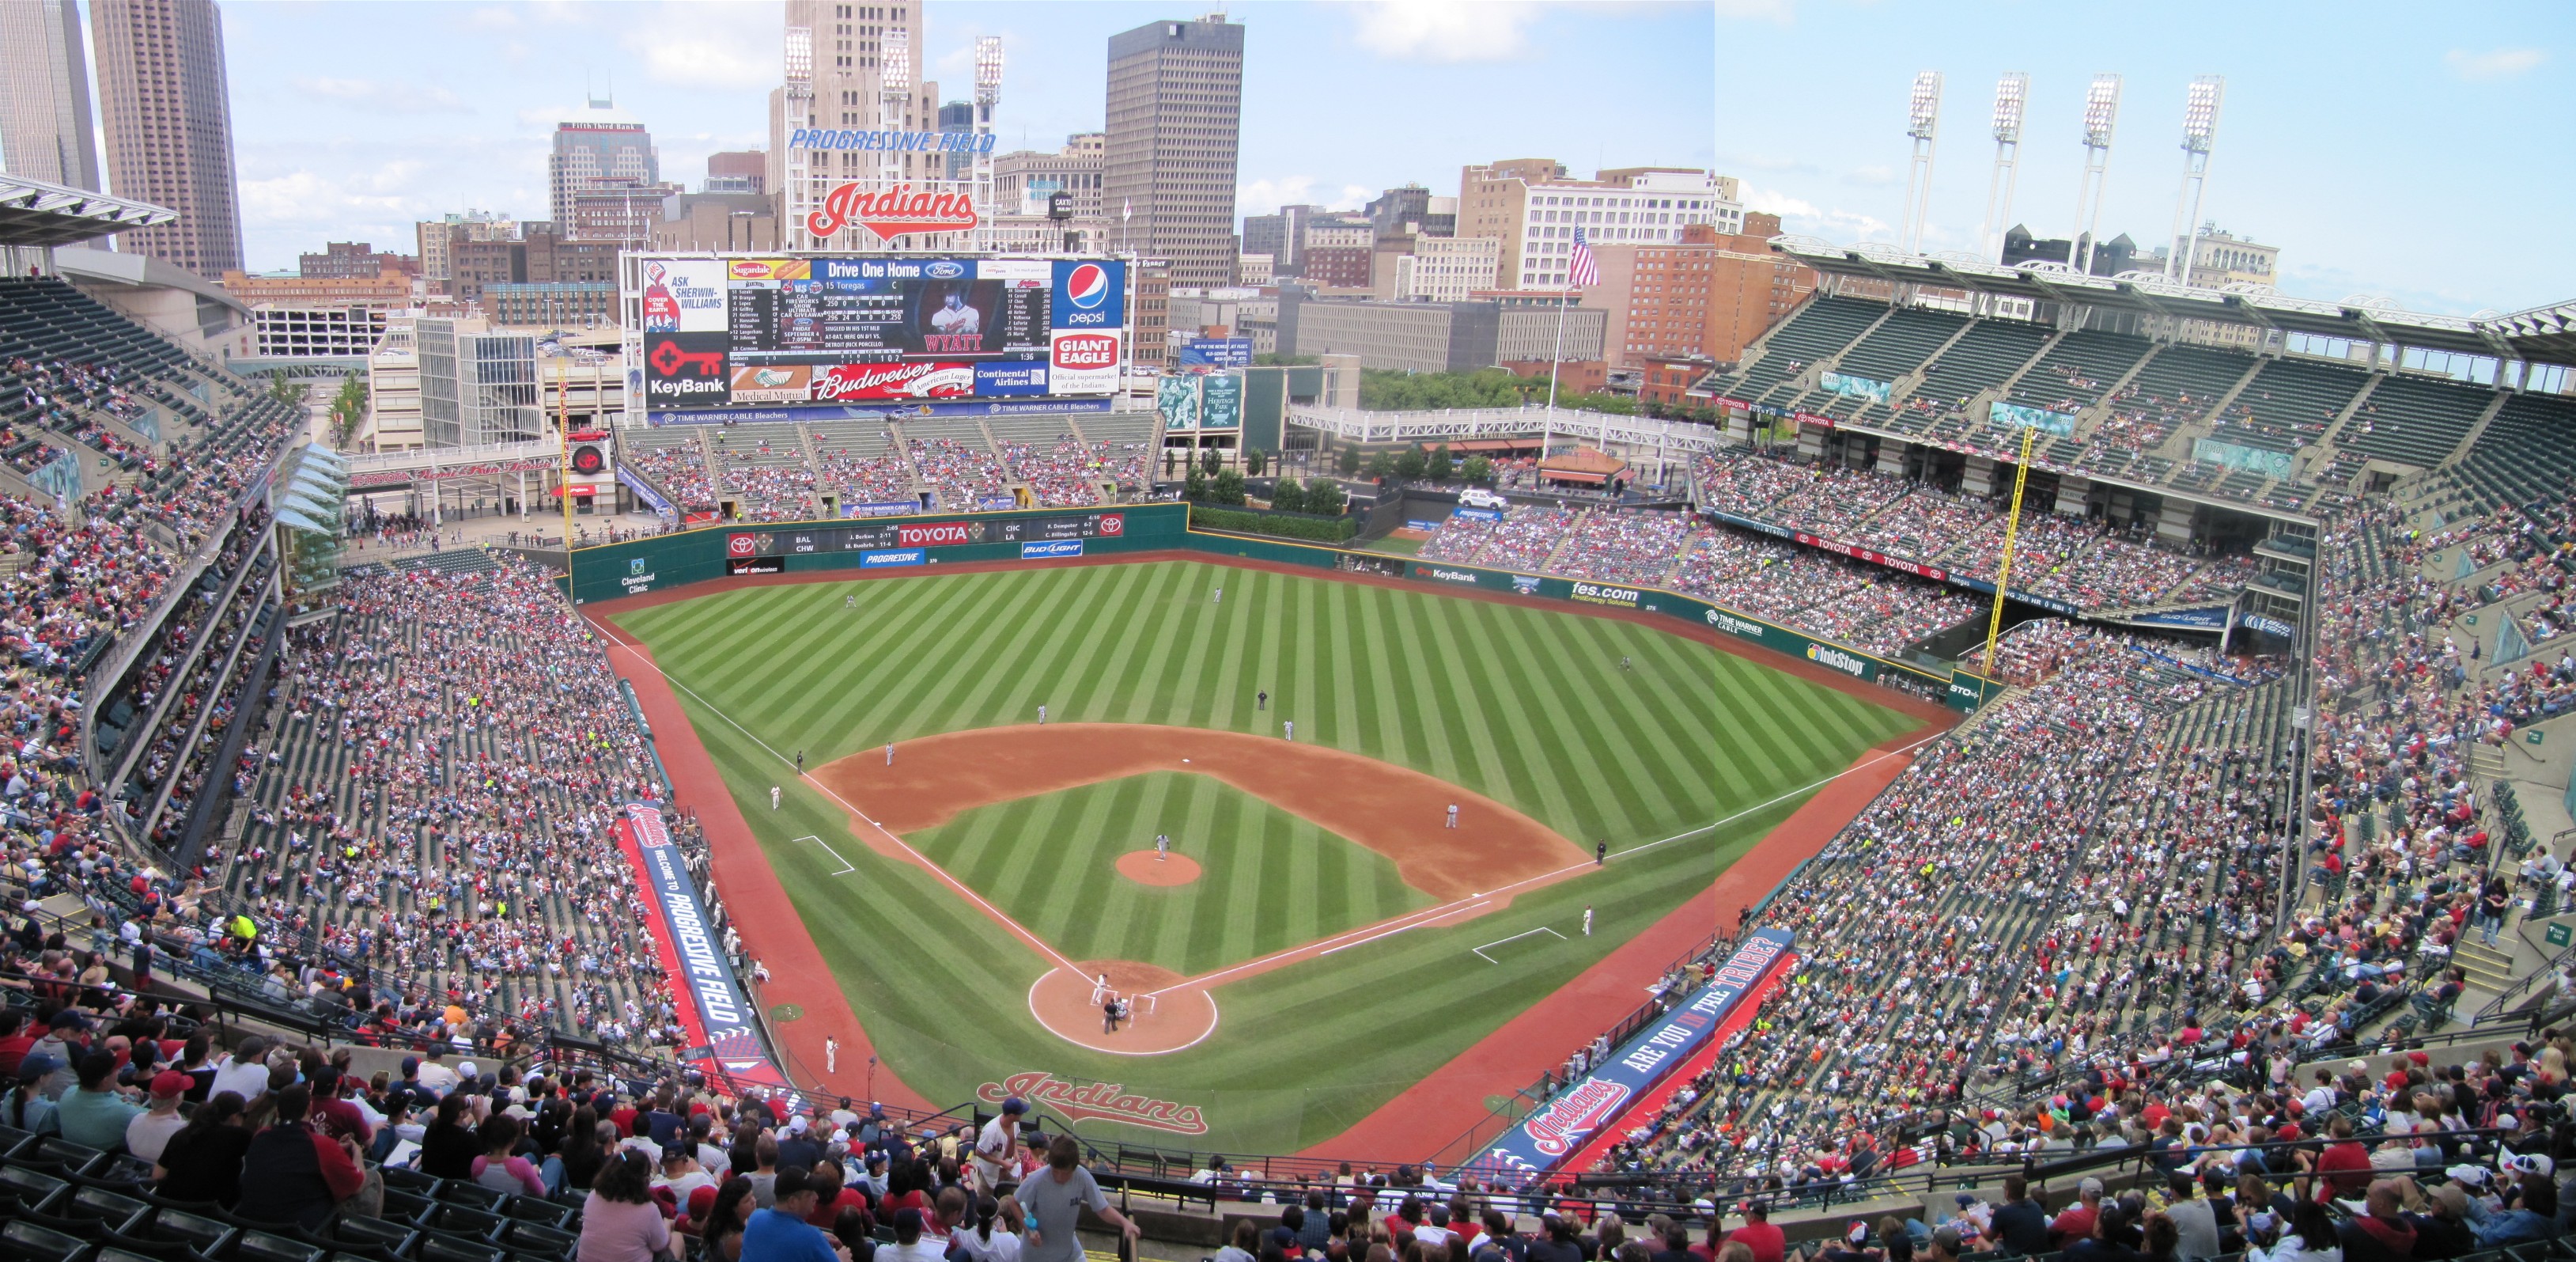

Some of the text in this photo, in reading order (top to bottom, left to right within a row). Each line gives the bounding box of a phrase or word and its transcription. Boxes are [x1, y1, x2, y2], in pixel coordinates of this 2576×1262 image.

[789, 129, 997, 153] PROGRESSIVE FIELD
[807, 180, 979, 243] Indians
[733, 263, 770, 276] Sugardale
[829, 263, 920, 278] Drive One Home
[933, 264, 955, 275] Ford
[671, 277, 689, 286] ASK
[675, 288, 717, 298] SHERWIN-
[681, 298, 722, 309] WILLIAMS
[1069, 311, 1105, 325] pepsi
[925, 334, 983, 351] WYATT
[1059, 340, 1112, 351] GIANT
[1061, 352, 1110, 364] EAGLE
[977, 369, 1029, 378] Continental
[651, 378, 724, 396] KeyBank
[813, 362, 934, 400] Budweiser
[916, 373, 971, 392] American Lager
[994, 377, 1029, 386] Airlines
[736, 390, 806, 401] Medical Mutual
[1725, 400, 1745, 409] TOYOTA
[560, 381, 569, 460] WALGREENS
[1807, 416, 1829, 426] TOYOTA
[1449, 434, 1482, 442] MARKET
[2199, 442, 2226, 455] LEMON
[365, 472, 410, 484] TOYOTA
[623, 471, 659, 501] TIME WARNER CABLE
[640, 490, 656, 506] Bleachers
[1459, 510, 1495, 518] PROGRESSIVE
[900, 526, 966, 543] TOYOTA
[1818, 539, 1852, 555] TOYOTA
[866, 553, 919, 564] PROGRESSIVE
[1883, 556, 1919, 574] TOYOTA
[622, 573, 655, 586] Cleveland
[1432, 569, 1476, 582] KeyBank
[629, 584, 649, 594] Clinic
[1572, 582, 1639, 601] fes.com
[1949, 574, 1970, 586] Toregas
[2052, 603, 2064, 612] RBI
[1571, 594, 1636, 608] FirstEnergy Solutions
[1718, 623, 1738, 634] CABLE
[1719, 614, 1763, 635] TIME WARNER
[2262, 623, 2290, 638] LIGHT
[2268, 620, 2290, 632] BUD
[1820, 646, 1863, 676] InkStop
[1950, 684, 1971, 696] STO
[625, 803, 674, 848] Indians
[655, 850, 740, 1024] WELCOME TO PROGRESSIVE FIELD
[1525, 936, 1785, 1155] Indians ARE YOU IN THE TRIBE?
[977, 1071, 1209, 1135] Indians
